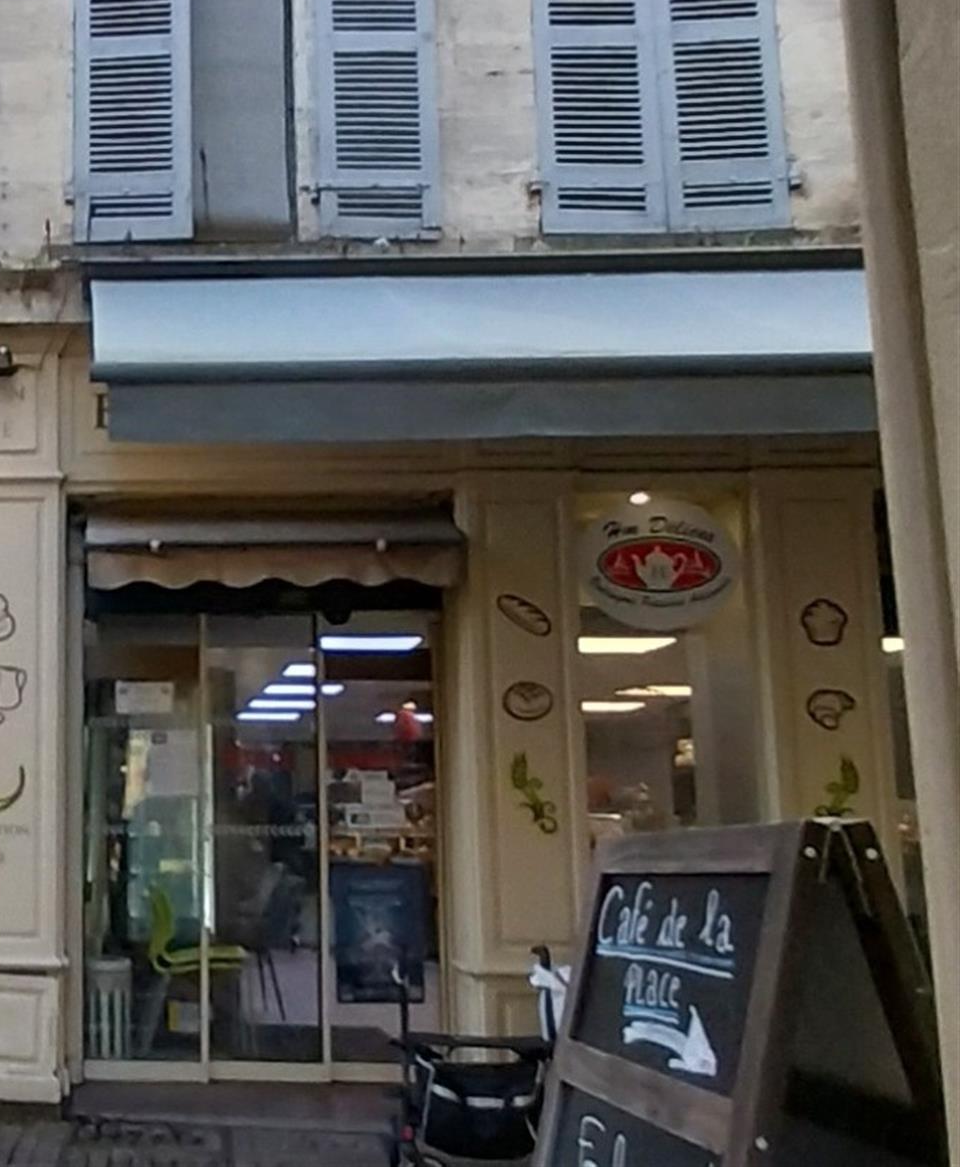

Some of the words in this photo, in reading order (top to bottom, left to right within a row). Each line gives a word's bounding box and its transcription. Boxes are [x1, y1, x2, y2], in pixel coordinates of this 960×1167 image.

[597, 881, 654, 945] Café
[656, 897, 688, 949] de
[698, 888, 735, 954] la
